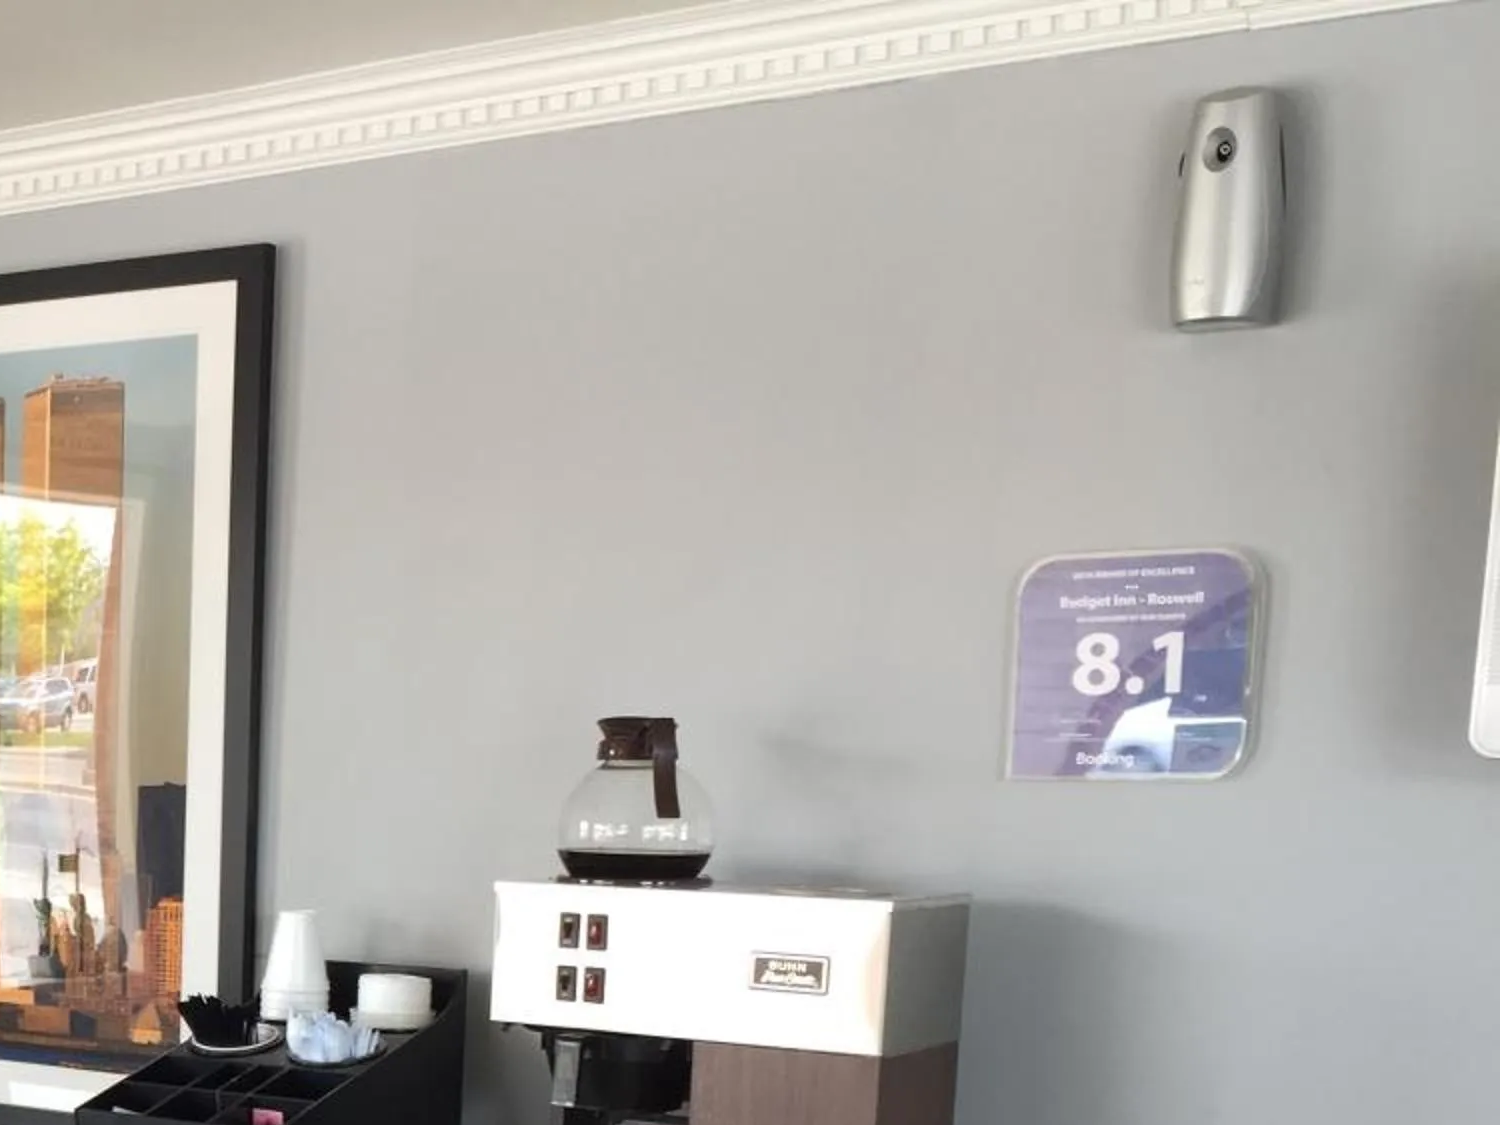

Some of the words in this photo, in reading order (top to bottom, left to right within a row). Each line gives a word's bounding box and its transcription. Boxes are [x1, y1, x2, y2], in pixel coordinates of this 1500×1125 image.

[1059, 594, 1112, 610] Budget
[1113, 593, 1137, 607] Inn
[1147, 591, 1205, 606] Roswell
[1072, 631, 1185, 697] 8.1
